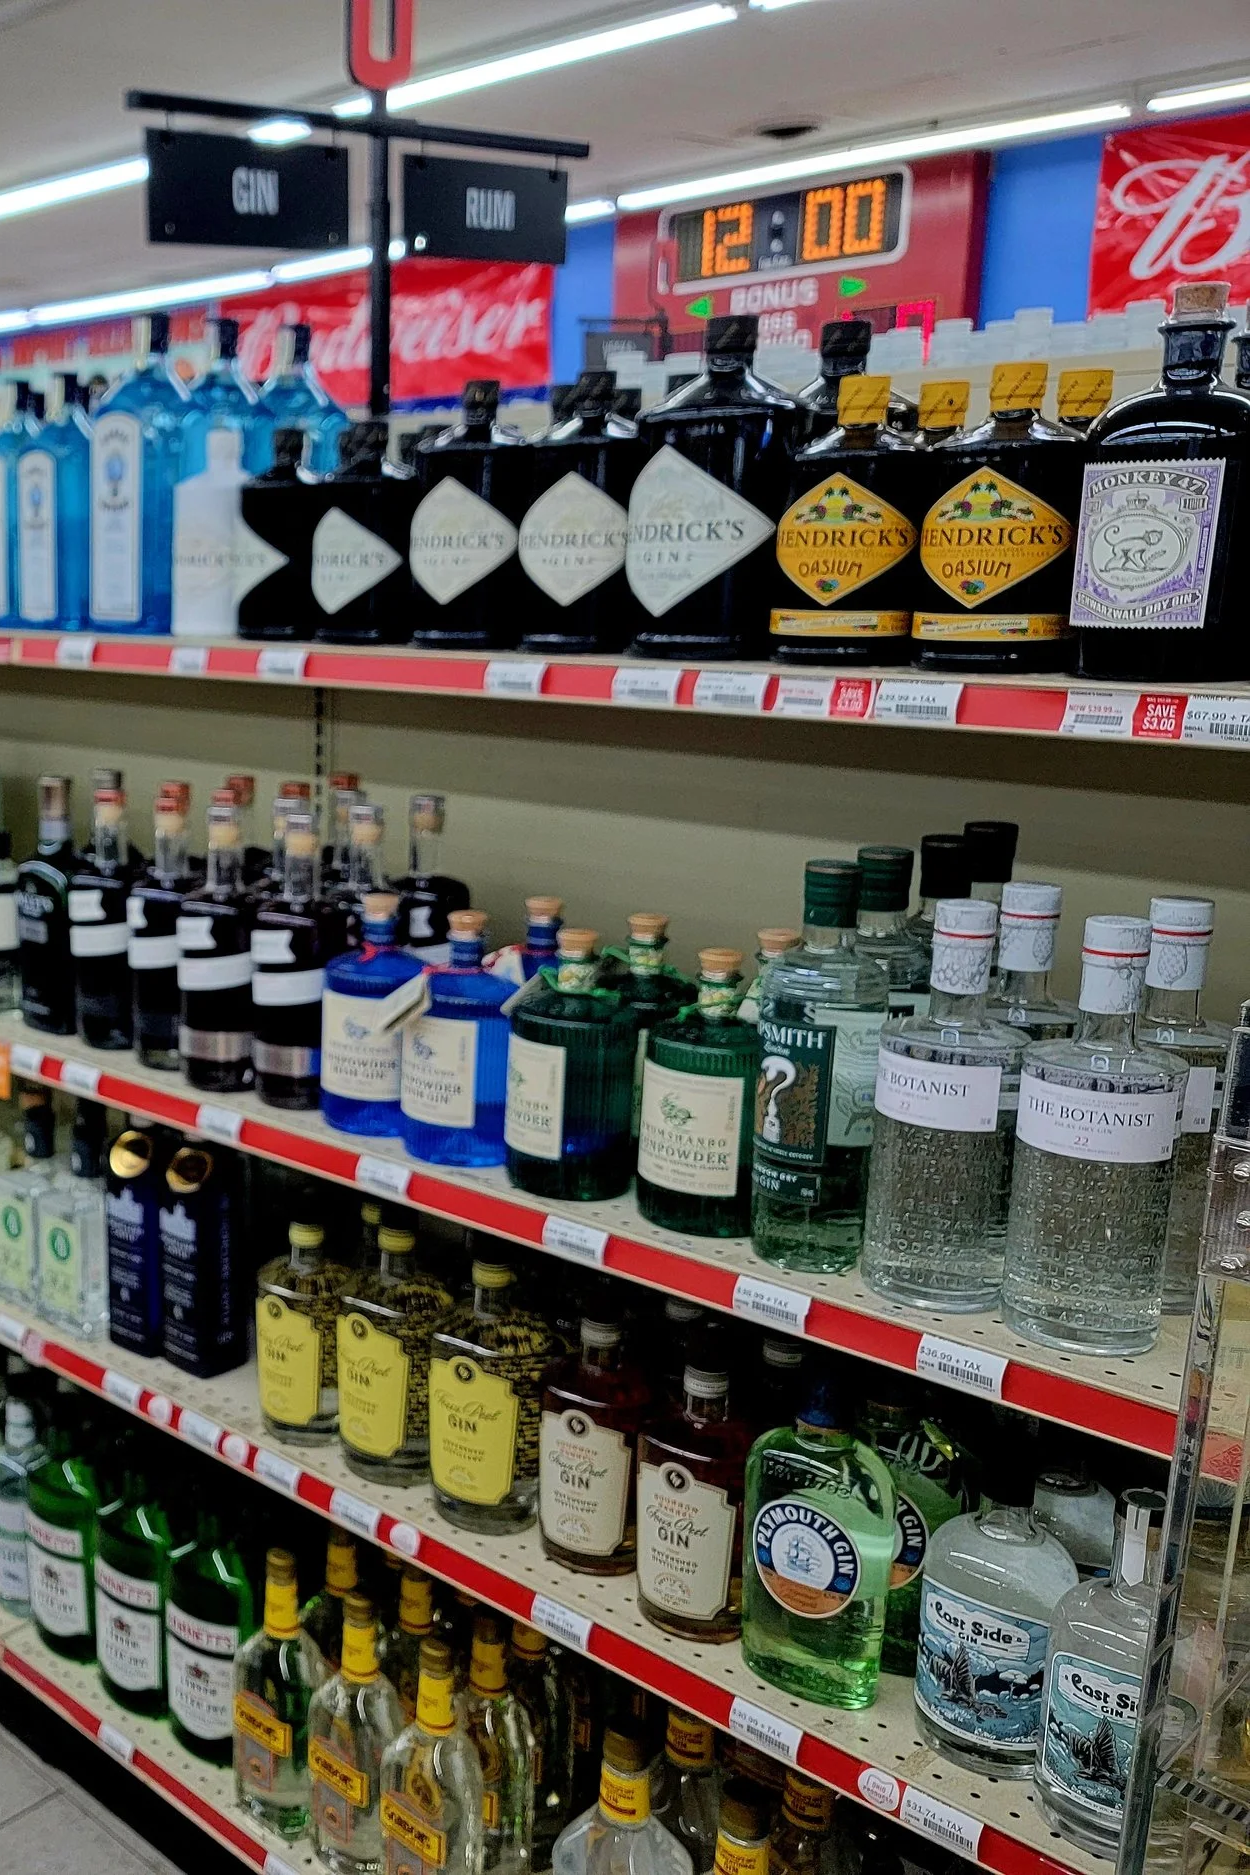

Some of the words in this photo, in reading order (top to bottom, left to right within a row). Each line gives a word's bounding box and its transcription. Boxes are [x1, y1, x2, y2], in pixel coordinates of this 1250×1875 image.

[231, 167, 279, 216] GIN
[464, 187, 516, 231] RUM
[730, 276, 819, 314] BONUS
[1091, 471, 1177, 494] MONKEY
[1178, 477, 1204, 492] 47
[644, 551, 679, 563] GIN
[799, 559, 862, 577] OASIUM
[942, 560, 1011, 578] OASIUM
[1147, 704, 1177, 717] SAVE
[1187, 711, 1226, 721] $67.99
[1142, 717, 1175, 732] $3.00
[890, 1074, 969, 1097] BOTANIST
[1028, 1095, 1055, 1117] THE
[1060, 1108, 1154, 1127] BOTANIST
[1073, 1136, 1089, 1147] 22
[759, 1175, 780, 1191] GIN
[919, 1345, 952, 1361] $36.99
[963, 1359, 982, 1372] TAX
[448, 1413, 478, 1434] GIN
[560, 1470, 590, 1490] GIN
[658, 1526, 690, 1549] GIN
[757, 1505, 841, 1549] PLYMOUTH
[833, 1541, 854, 1578] GIN
[902, 1514, 923, 1548] GIN
[958, 1632, 978, 1645] GIN
[971, 1621, 1013, 1644] Side
[1072, 1673, 1110, 1704] East
[1116, 1693, 1138, 1712] Si
[1101, 1705, 1124, 1718] GIN
[906, 1799, 937, 1820] $31.74
[947, 1819, 963, 1833] TAX
